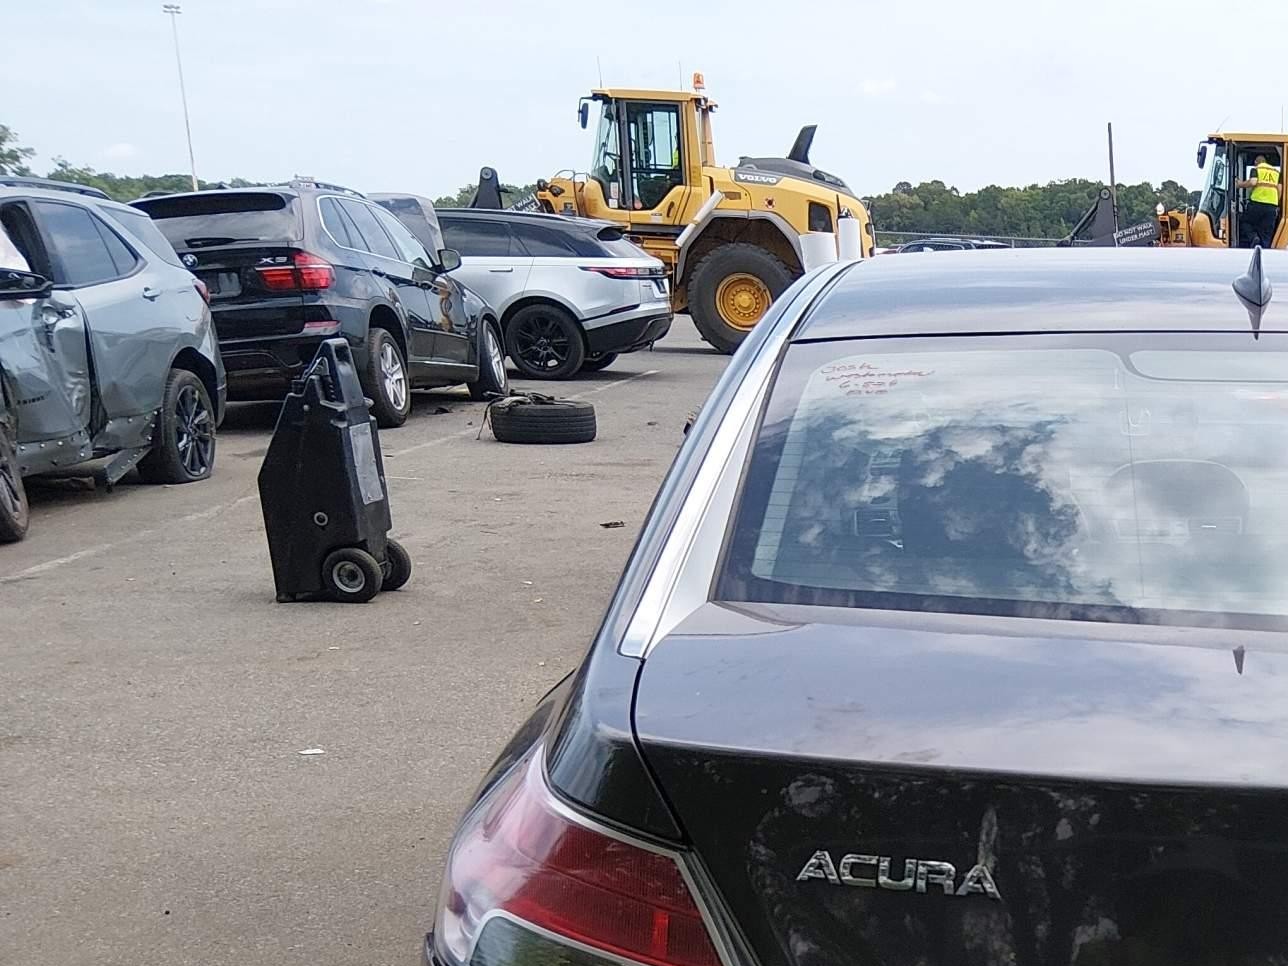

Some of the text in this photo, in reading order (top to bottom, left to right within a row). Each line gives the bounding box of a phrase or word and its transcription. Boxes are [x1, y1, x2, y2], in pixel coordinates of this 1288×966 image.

[738, 174, 777, 184] VOLVO
[1119, 229, 1153, 243] UNDER MAST
[1124, 227, 1136, 236] NOT
[1137, 222, 1153, 231] WALK
[796, 850, 1001, 900] ACURA
